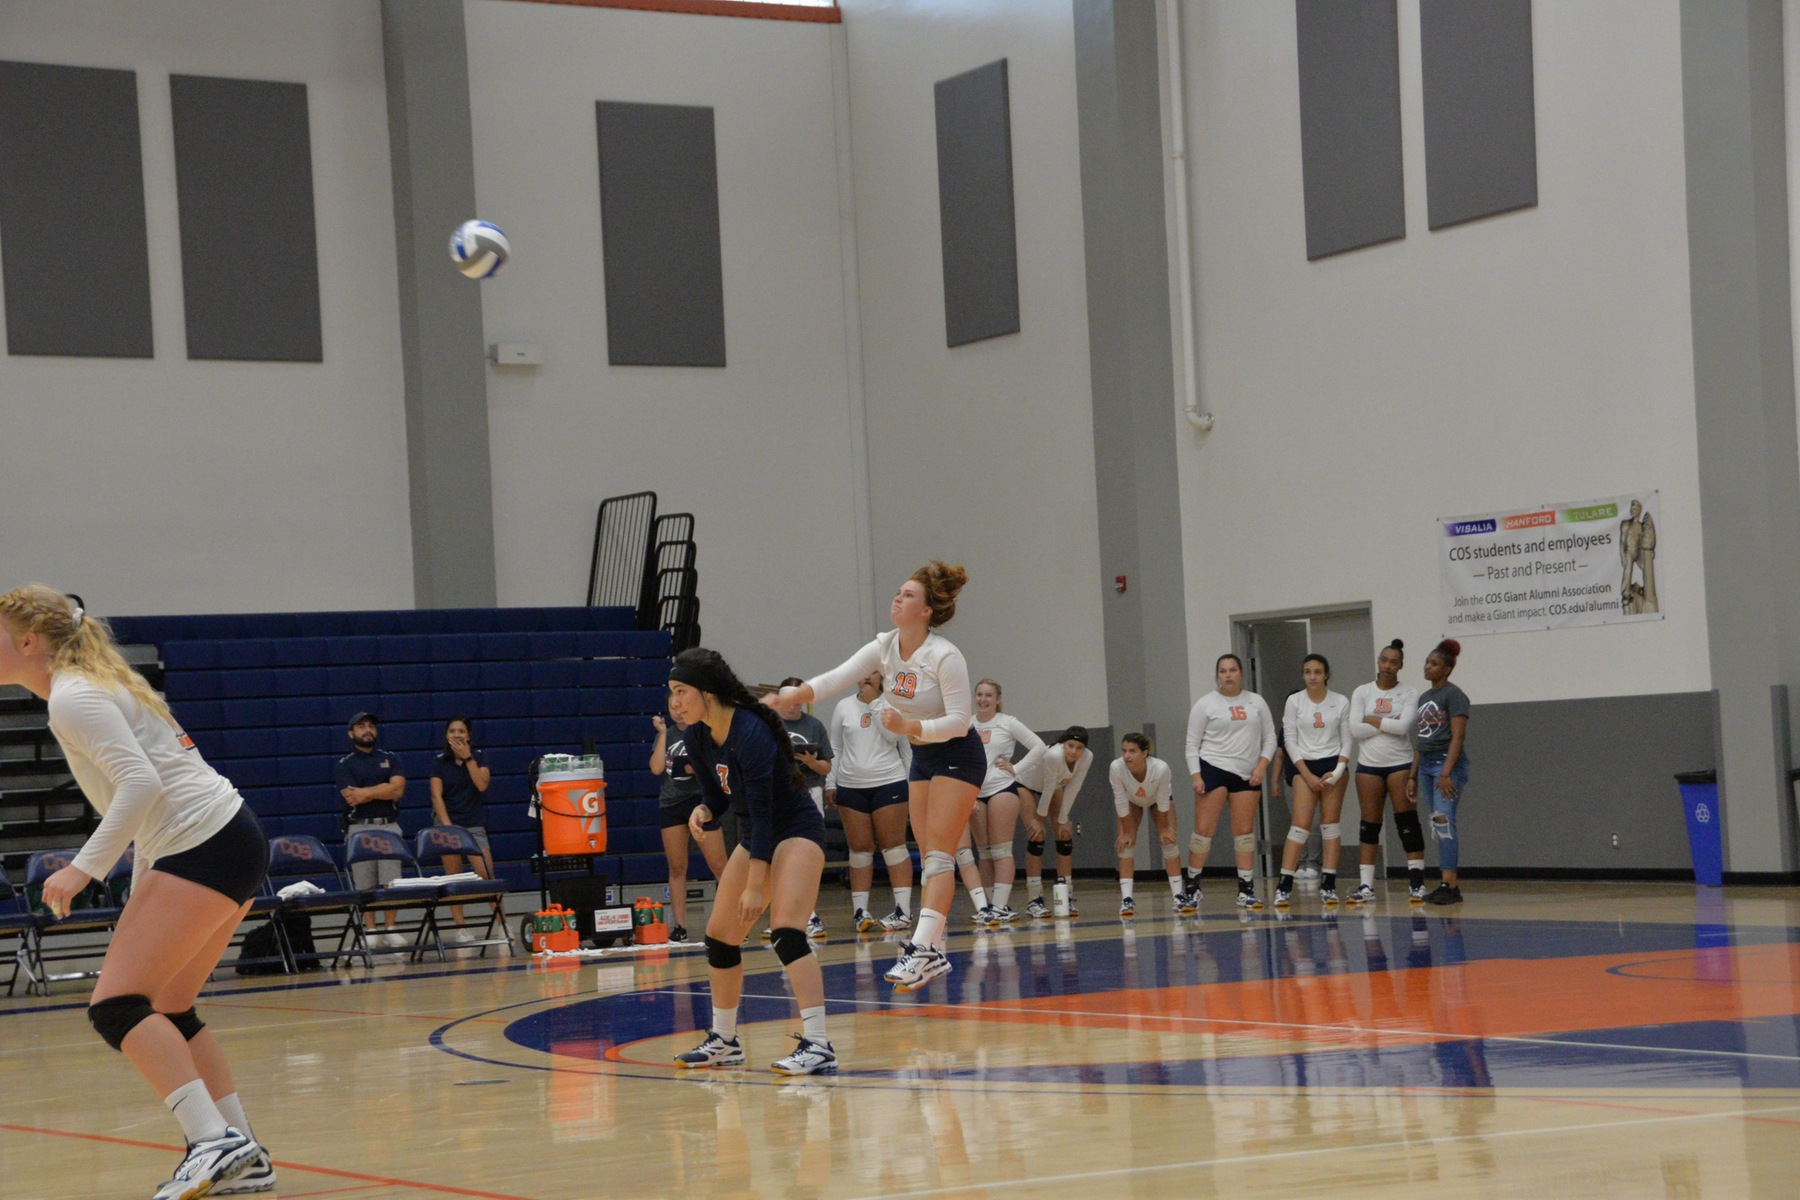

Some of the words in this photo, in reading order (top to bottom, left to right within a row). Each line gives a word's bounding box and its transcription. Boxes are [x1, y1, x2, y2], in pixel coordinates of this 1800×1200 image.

[1506, 514, 1552, 528] HANFORD
[1573, 507, 1614, 519] TULARE
[1455, 522, 1493, 534] VISALIA
[1449, 546, 1471, 561] COS
[1473, 542, 1522, 559] students
[1524, 537, 1545, 553] and
[1548, 533, 1612, 552] employees
[1487, 565, 1509, 579] Past
[1512, 561, 1532, 577] and
[1535, 559, 1576, 575] Present
[1454, 595, 1469, 607] Join
[1470, 594, 1483, 605] the
[1485, 592, 1502, 604] COS
[1504, 591, 1527, 603] Giant
[1529, 586, 1560, 600] Alumni
[1562, 582, 1612, 597] Association
[1448, 612, 1463, 624] and
[1465, 611, 1486, 623] make
[1487, 612, 1492, 621] a
[1493, 608, 1516, 620] Giant
[1549, 598, 1619, 616] COS.edu/alumni
[892, 672, 917, 699] 19
[1229, 706, 1247, 721] 16
[1374, 697, 1393, 714] 15
[860, 713, 872, 728] 6
[1313, 711, 1325, 728] 1
[716, 763, 731, 795] 7
[582, 792, 599, 813] G
[279, 837, 313, 860] COS
[361, 833, 393, 855] COS
[430, 829, 462, 849] COS
[539, 936, 546, 949] G
